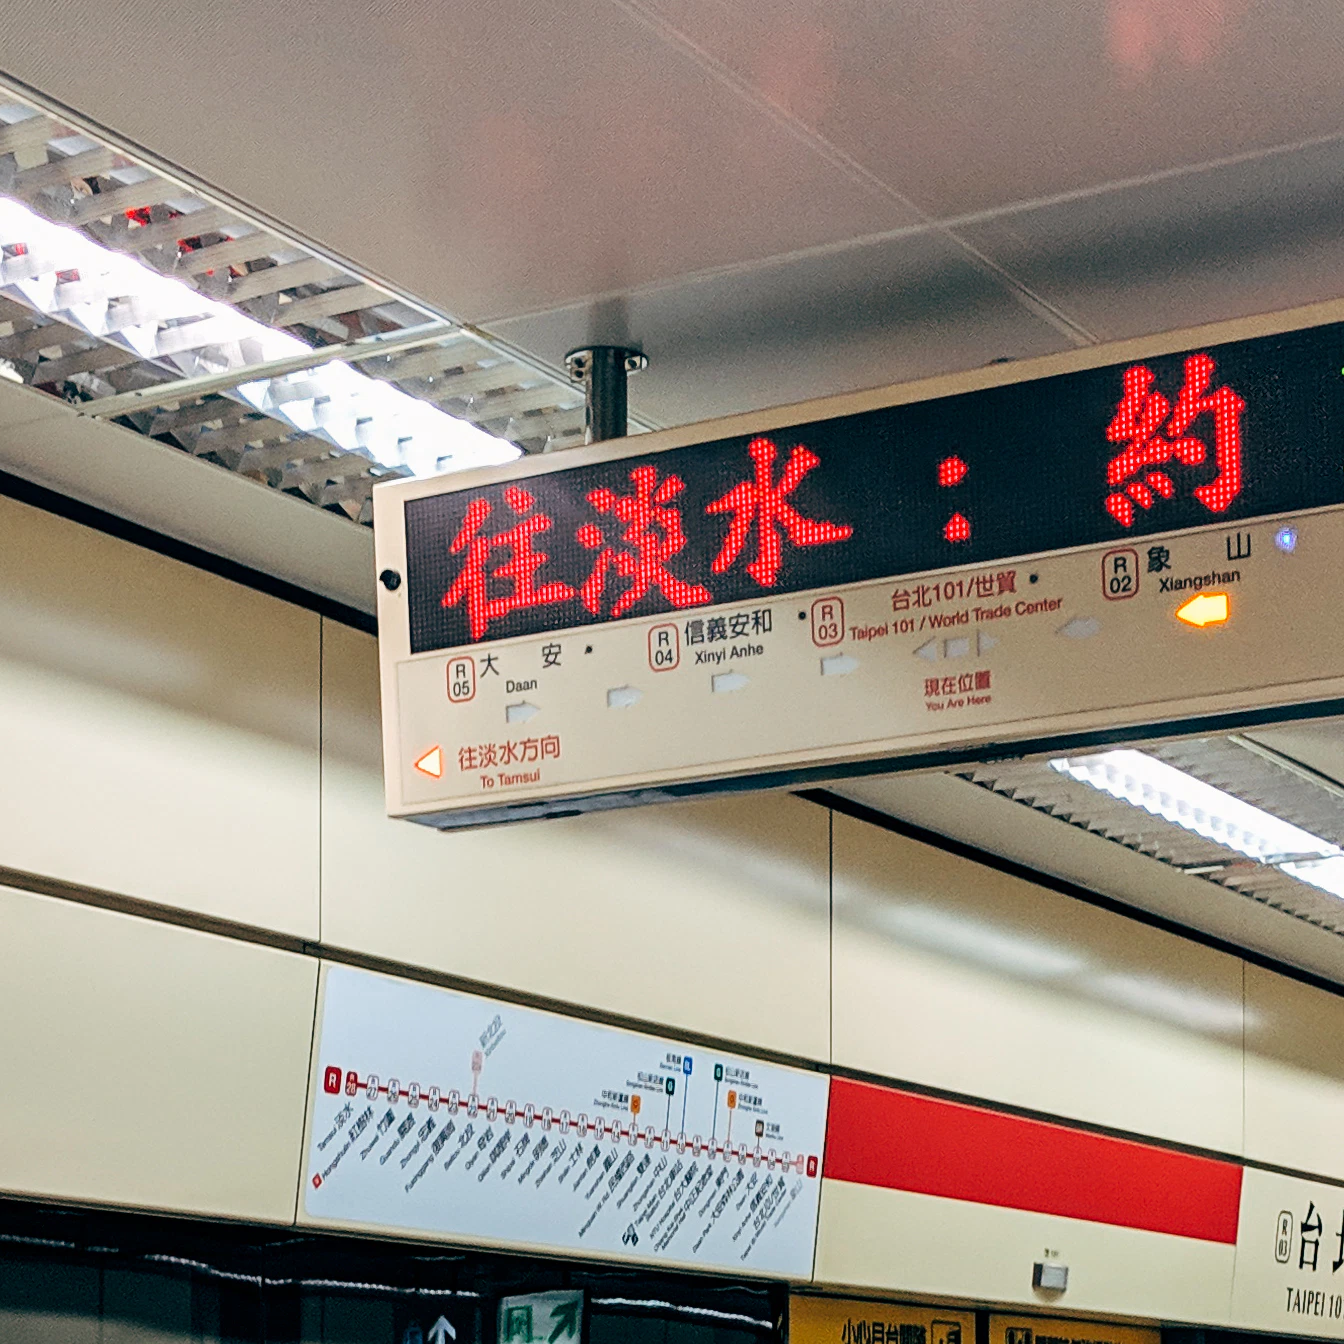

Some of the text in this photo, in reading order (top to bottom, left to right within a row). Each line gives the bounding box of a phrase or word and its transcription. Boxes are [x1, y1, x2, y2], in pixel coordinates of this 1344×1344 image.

[442, 438, 853, 641] 往淡水
[1106, 354, 1245, 527] 約
[1114, 557, 1128, 573] R
[1109, 576, 1132, 594] 02
[1159, 568, 1241, 594] Xiangshan
[891, 570, 1017, 612] 台北101/世貿
[821, 605, 834, 621] R
[849, 623, 888, 642] Taipei
[891, 617, 915, 633] 101
[928, 610, 970, 629] World
[972, 604, 1011, 622] Trade
[1015, 598, 1063, 616] Center
[684, 609, 773, 647] 信義安和
[818, 623, 838, 640] 03
[657, 632, 669, 646] R
[655, 648, 673, 666] 04
[694, 643, 764, 665] Xinyi Anhe
[455, 664, 466, 679] R
[453, 681, 470, 697] 05
[505, 677, 538, 694] Daan
[923, 670, 991, 697] 現在位置
[925, 694, 991, 712] You Are Here
[458, 735, 560, 771] 往淡水方向
[480, 768, 541, 789] To Tamsui
[1281, 1219, 1289, 1236] R
[1279, 1239, 1289, 1257] 03
[1286, 1287, 1326, 1317] TAIPEI
